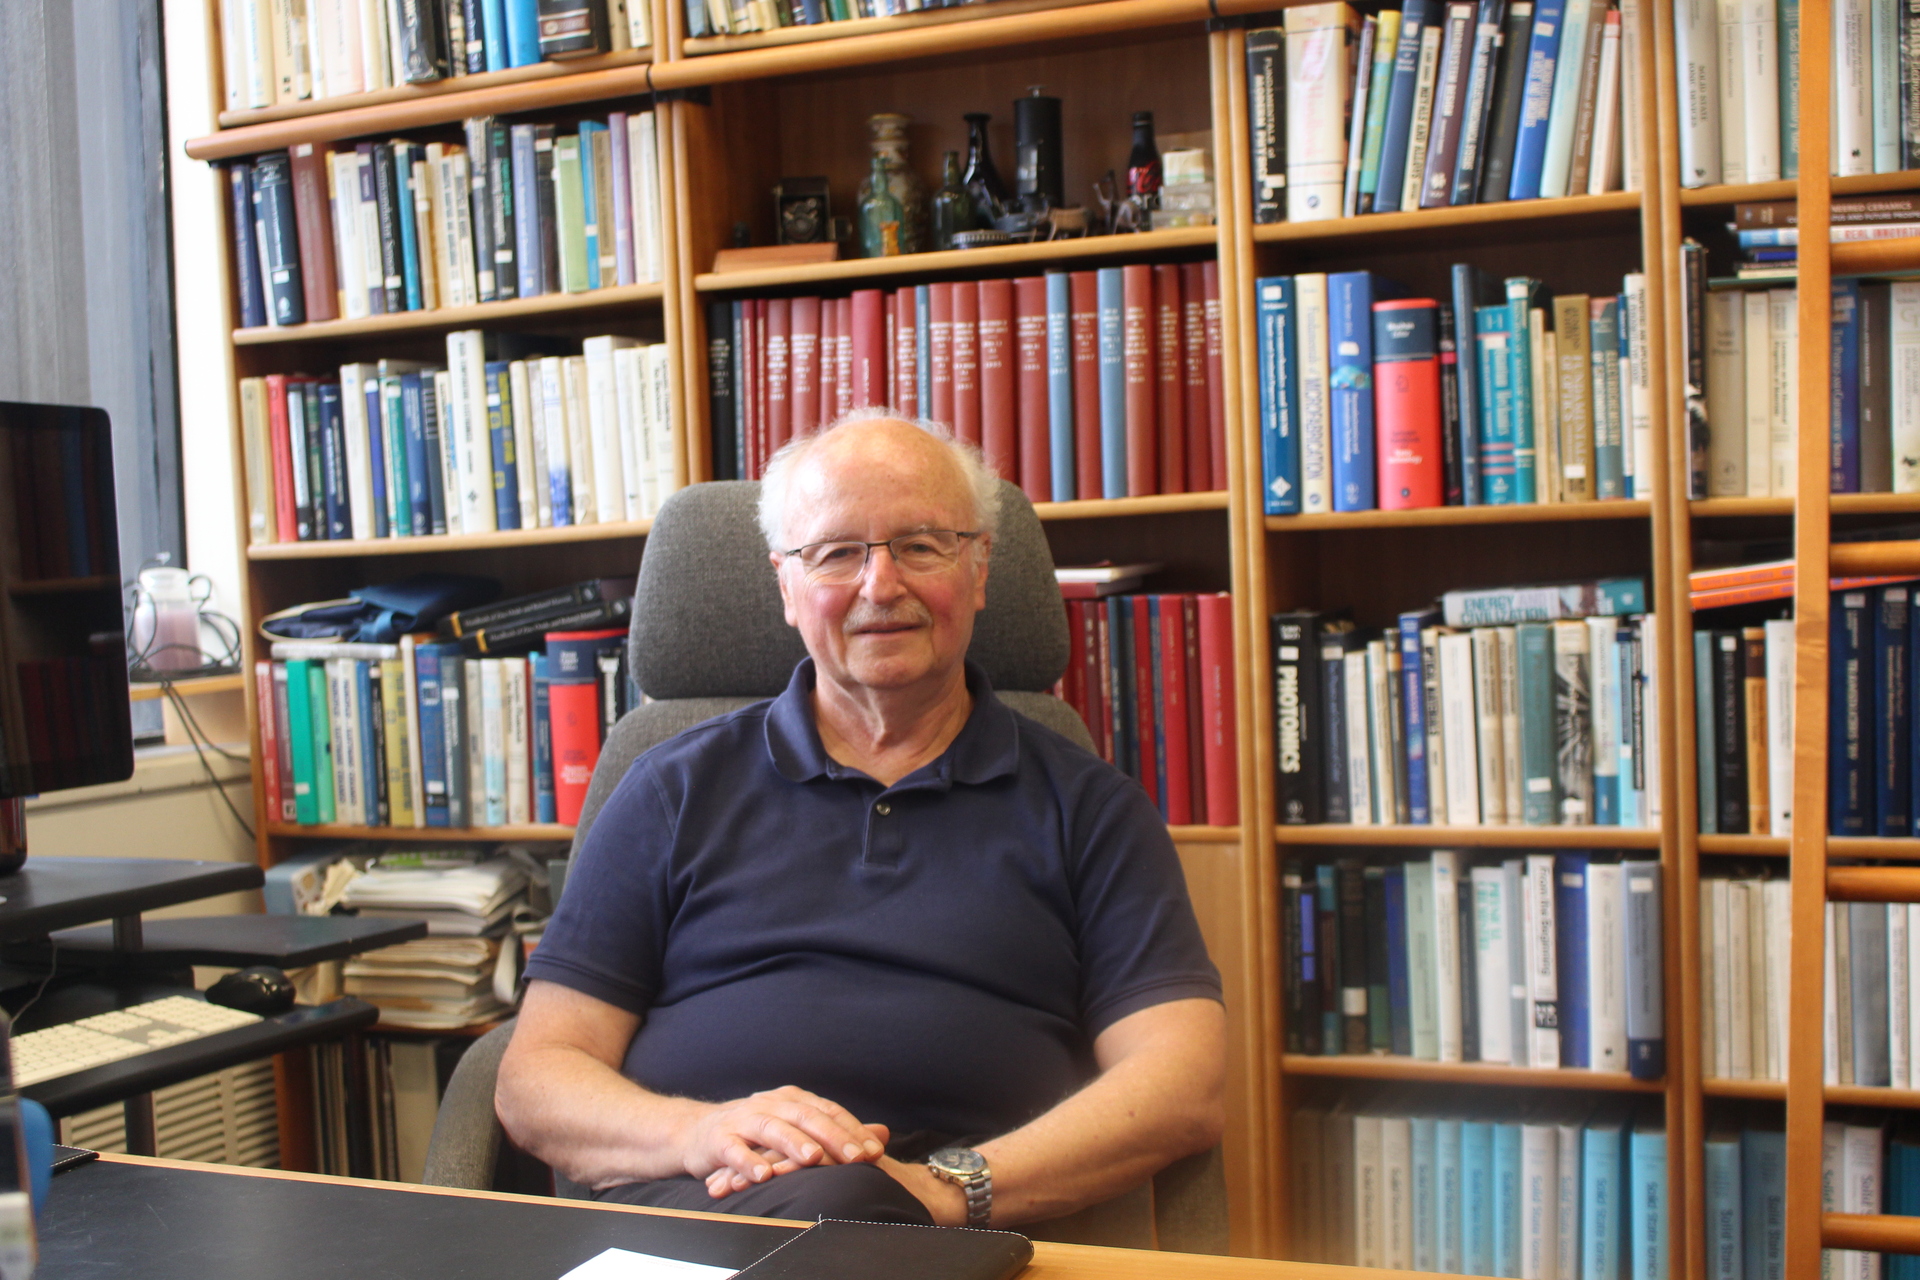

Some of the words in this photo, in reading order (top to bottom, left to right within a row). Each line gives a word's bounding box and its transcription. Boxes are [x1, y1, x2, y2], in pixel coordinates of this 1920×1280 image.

[1443, 85, 1458, 116] DESIGN
[1416, 124, 1427, 144] AND
[1562, 374, 1574, 422] OPTICS
[1572, 355, 1587, 465] FUNDAMENTALS
[1606, 350, 1620, 447] ELECTROCHEMISTRY
[1460, 605, 1549, 625] CIVILIZATION
[1463, 594, 1514, 614] ENERGY
[1276, 665, 1301, 773] PHOTONICS
[1860, 1174, 1874, 1205] Solid
